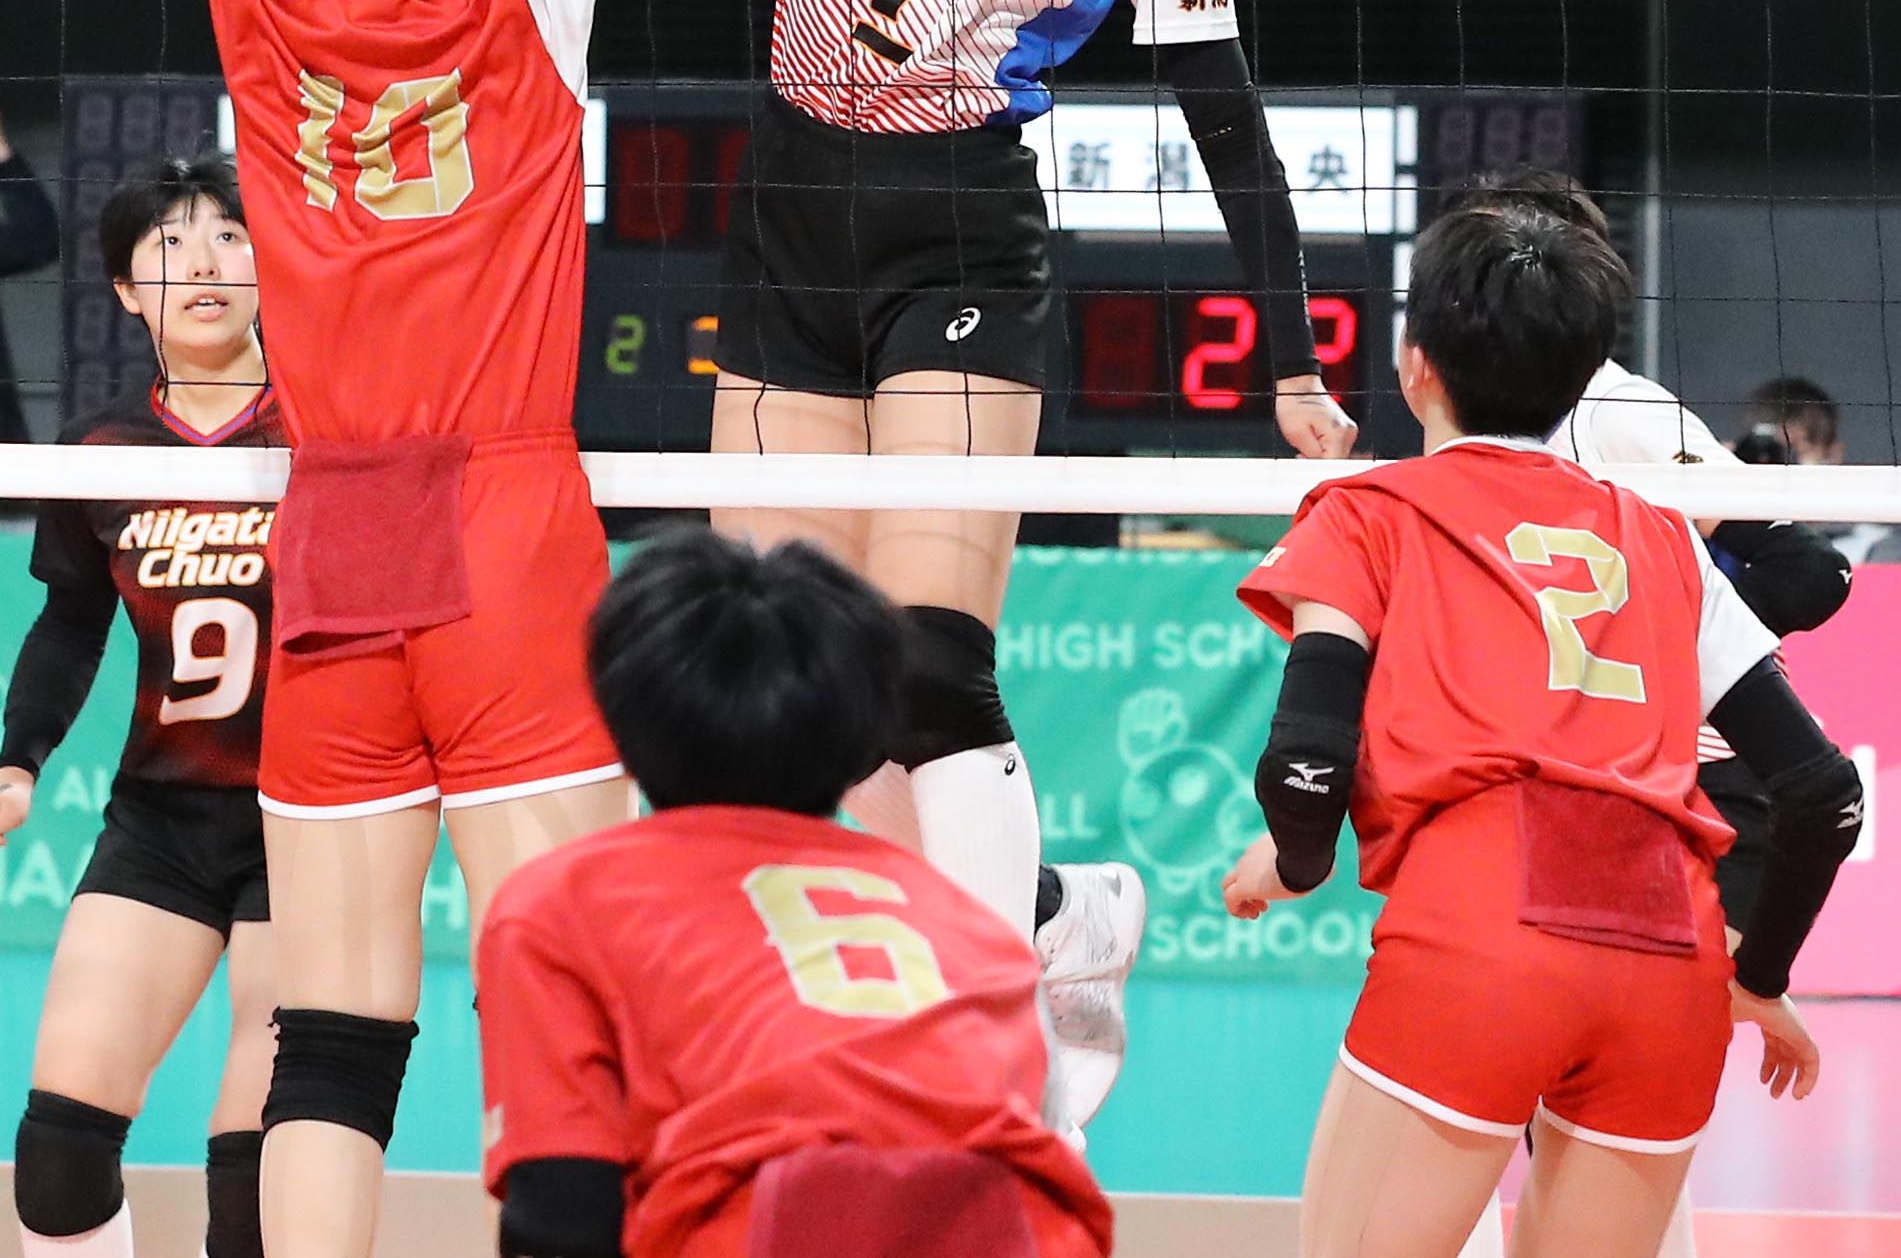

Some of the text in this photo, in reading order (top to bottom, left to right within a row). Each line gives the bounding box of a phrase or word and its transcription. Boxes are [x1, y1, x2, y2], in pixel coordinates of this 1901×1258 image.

[295, 67, 474, 220] 10
[138, 548, 265, 588] Chuo
[1504, 522, 1646, 703] 2
[158, 597, 258, 726] 9
[998, 622, 1290, 670] HIGH SCH
[742, 864, 953, 1018] 6
